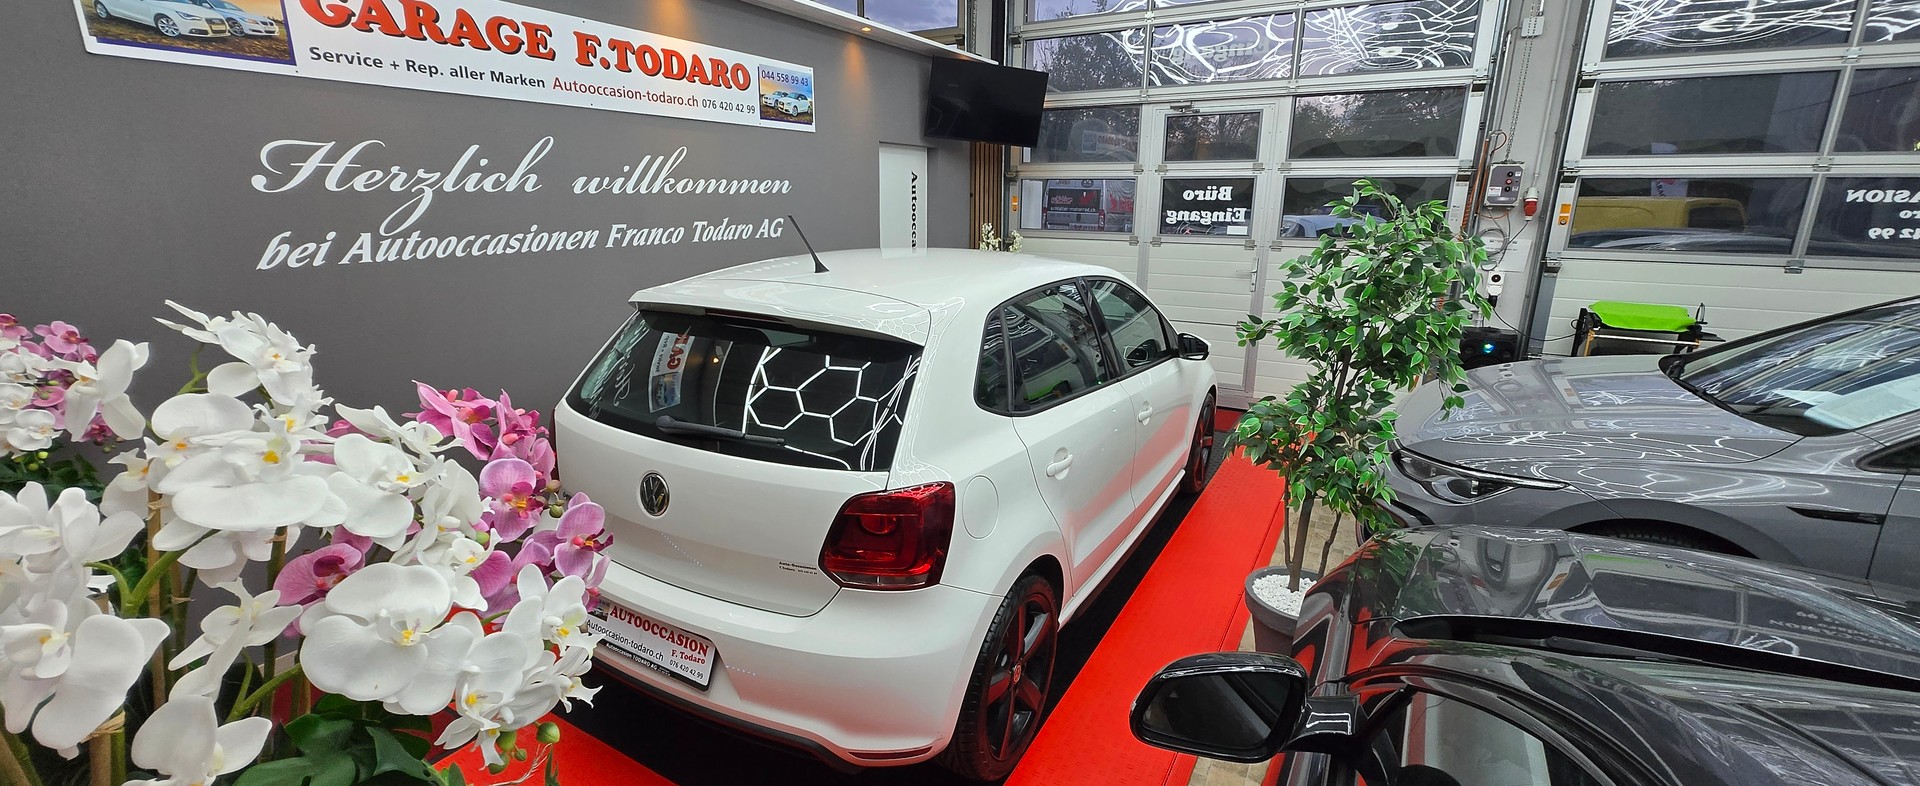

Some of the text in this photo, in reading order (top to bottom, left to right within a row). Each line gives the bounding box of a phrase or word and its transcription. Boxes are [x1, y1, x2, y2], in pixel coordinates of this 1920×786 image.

[298, 0, 751, 91] GARAGE F.TODARO
[308, 46, 756, 115] Service + Rep. aller Marken Autooccasion-todaro.ch 076 420 42 99
[761, 69, 809, 87] 044 558 99 43
[251, 136, 792, 236] Herzlich willkommen
[256, 217, 784, 270] bei Autooccasionen Franco Todaro AG
[610, 605, 709, 658] AUTOOCCASION
[671, 649, 706, 665] F. Todaro
